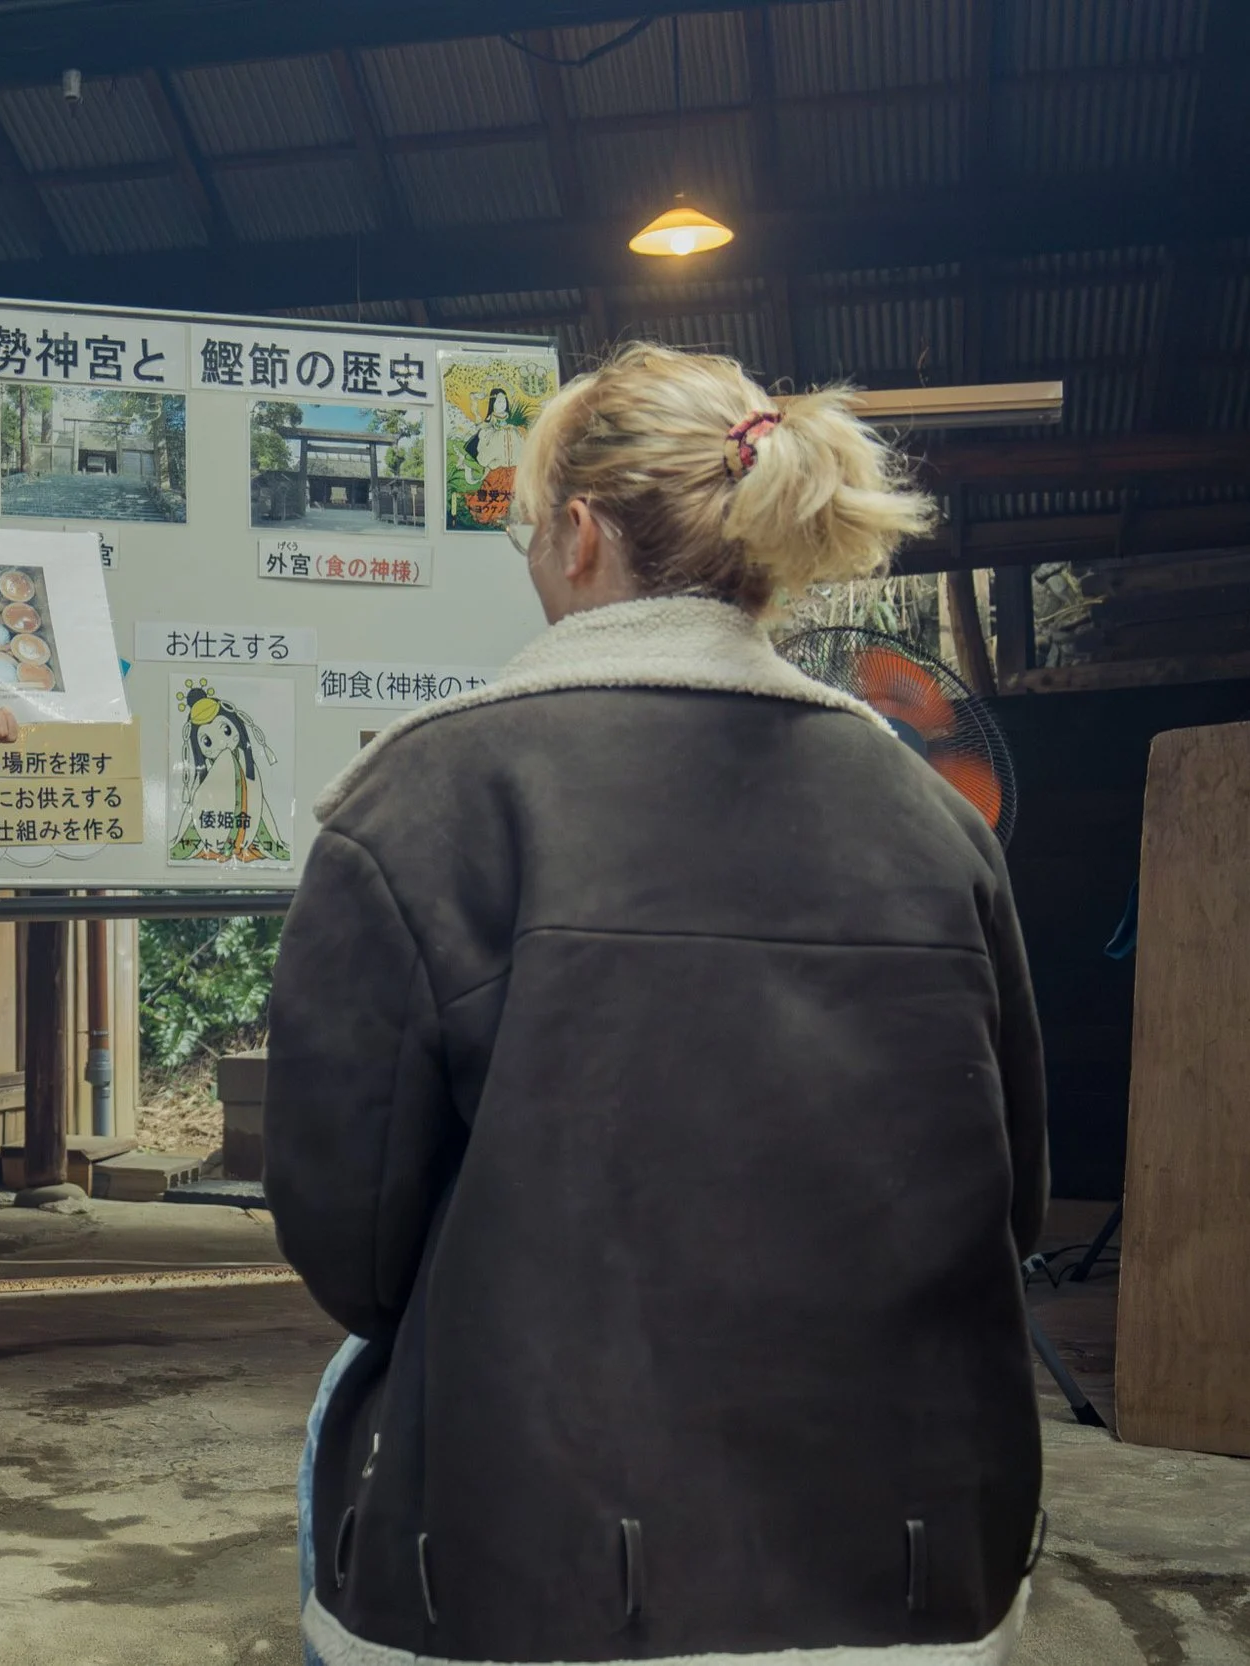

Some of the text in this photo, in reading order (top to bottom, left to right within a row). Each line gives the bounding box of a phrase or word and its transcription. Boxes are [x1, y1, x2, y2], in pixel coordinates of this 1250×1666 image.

[200, 337, 429, 398] 鰹節の歴史
[477, 489, 516, 502] 豊受大
[166, 631, 289, 660] お仕えする
[199, 810, 252, 830] 倭姫命
